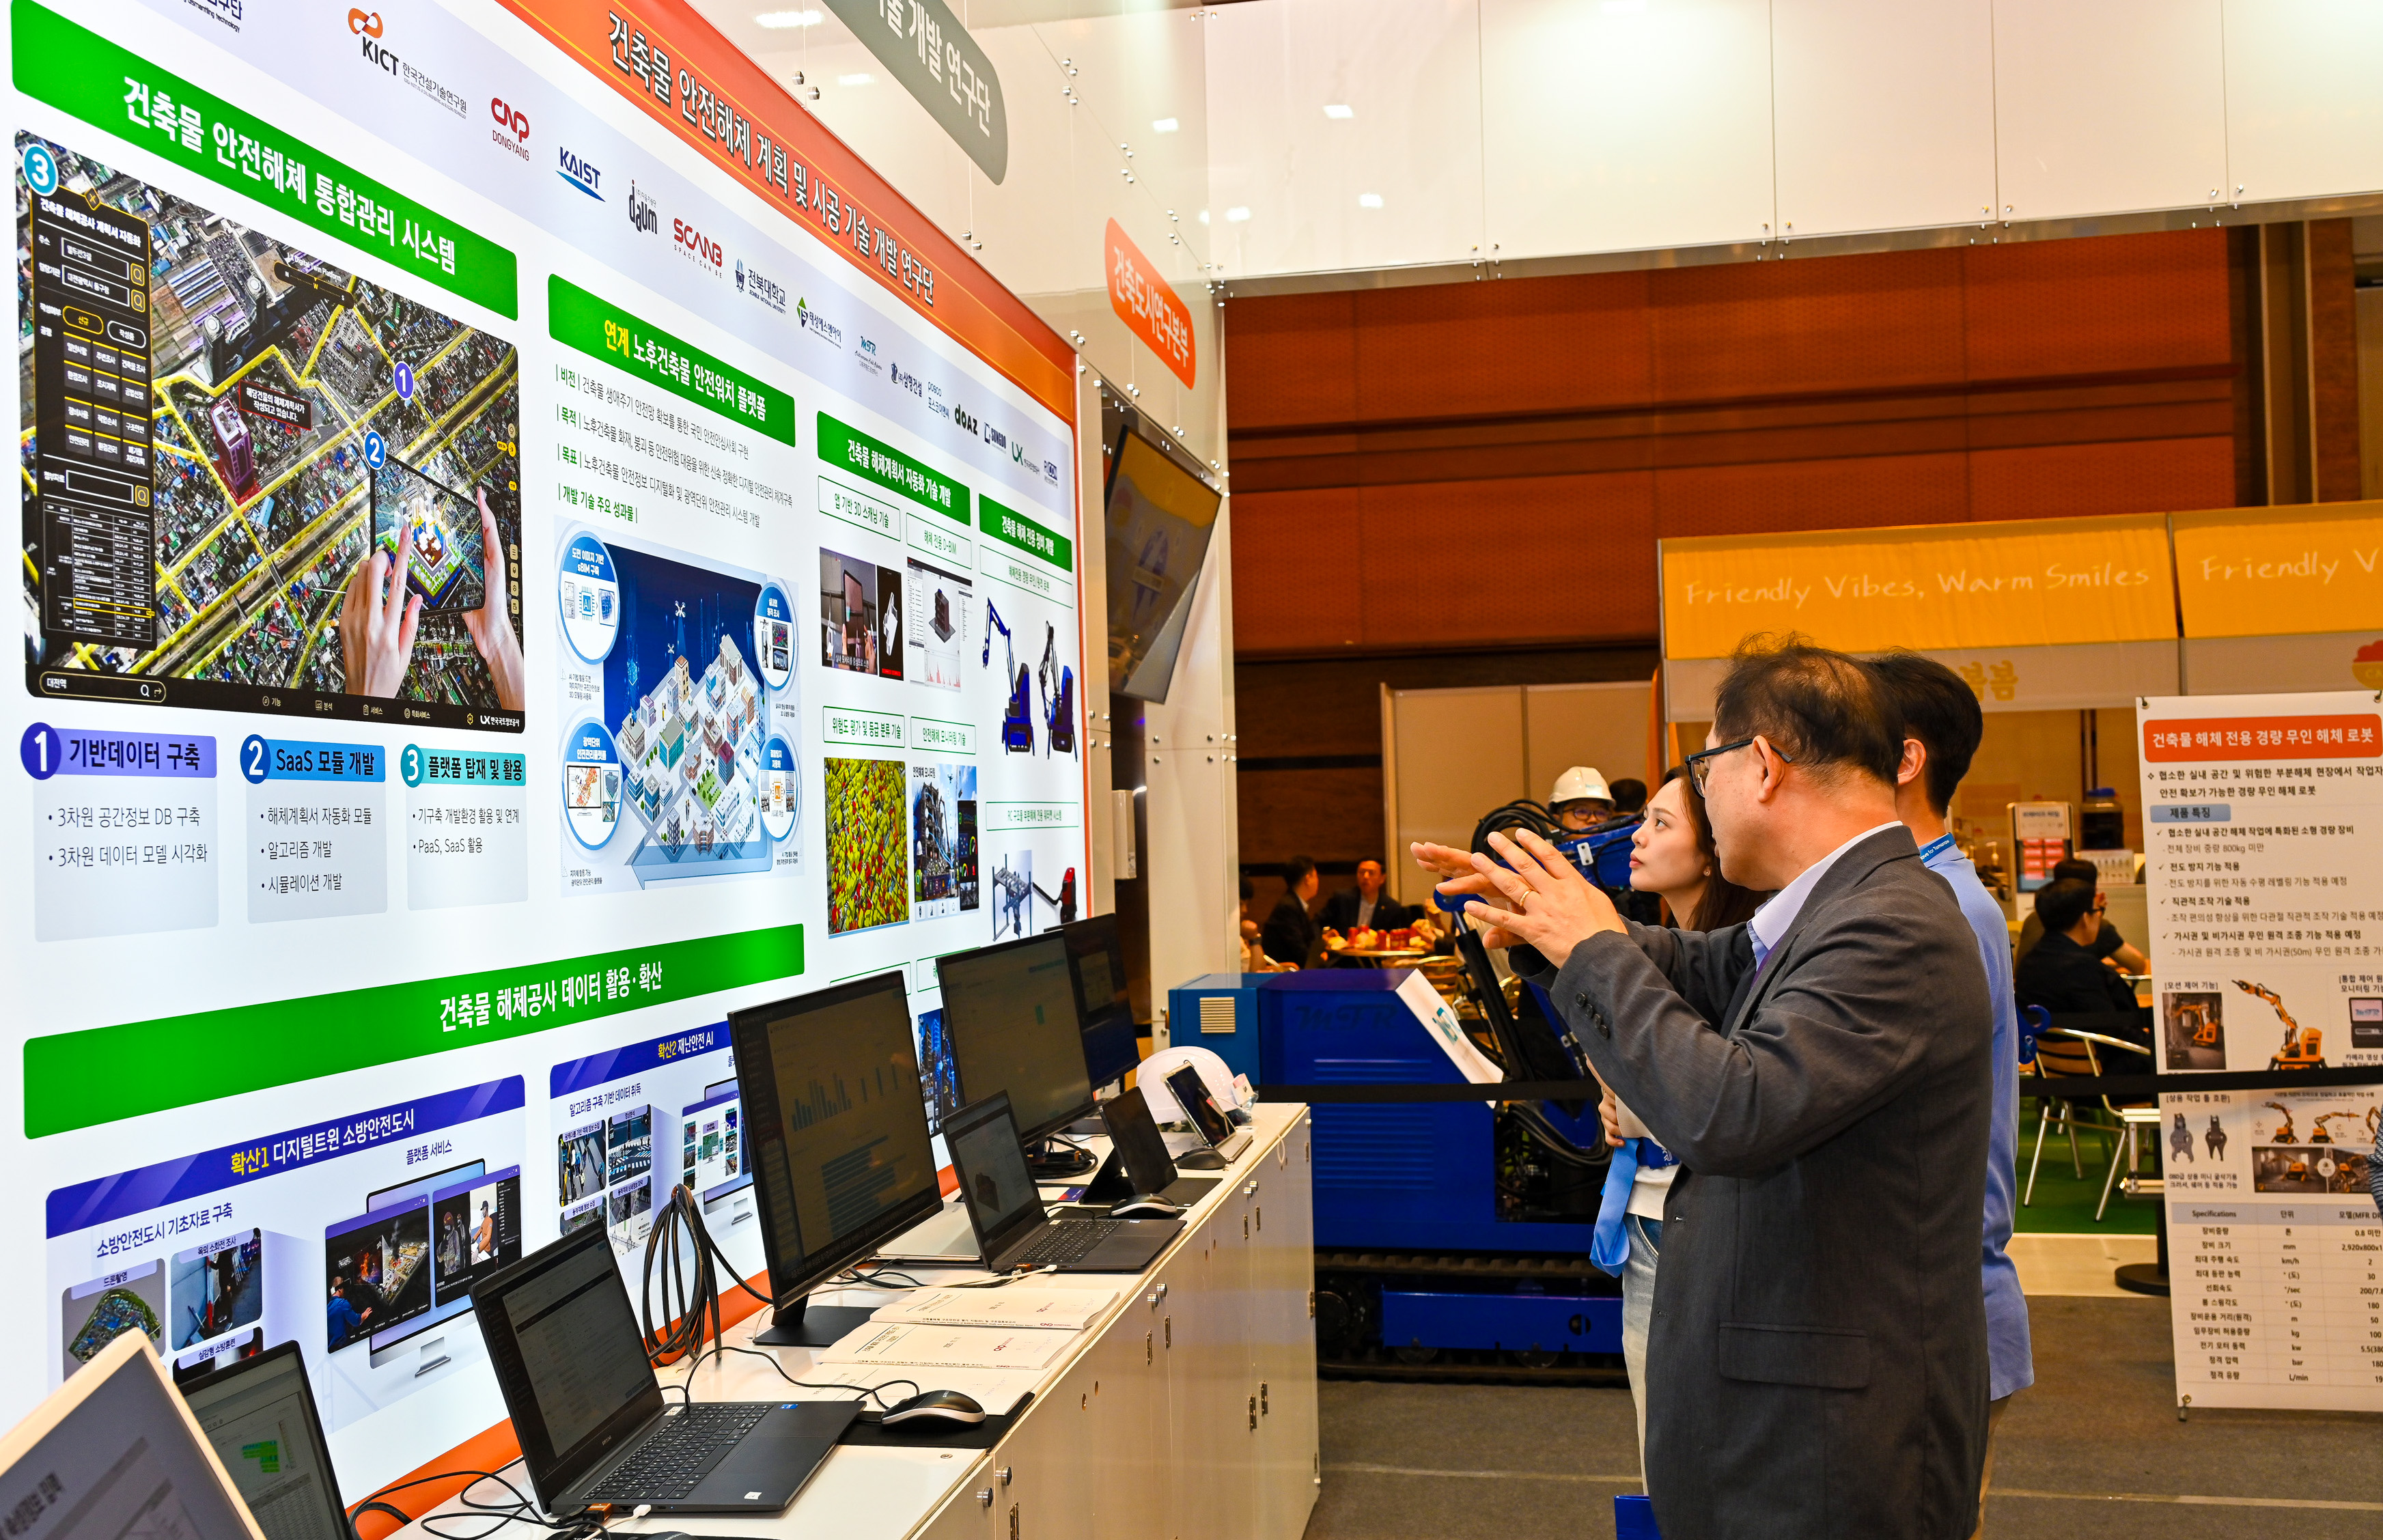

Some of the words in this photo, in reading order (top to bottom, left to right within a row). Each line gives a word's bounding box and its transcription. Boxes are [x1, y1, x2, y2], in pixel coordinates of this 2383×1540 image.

[363, 36, 398, 76] KICT
[879, 0, 904, 39] 술
[908, 0, 942, 83] 개발
[947, 42, 990, 138] 연구단
[403, 62, 466, 113] 한국건설기술연구원
[492, 130, 529, 161] DONGYANG
[608, 10, 672, 109] 건축물
[678, 68, 751, 169] 안전해체
[757, 122, 788, 199] 계획
[794, 161, 808, 210] 및
[812, 177, 839, 236] 시공
[846, 199, 870, 255] 기술
[874, 223, 897, 275] 개발
[901, 247, 934, 307] 연구단
[31, 154, 48, 186] 3
[124, 76, 202, 154] 건축물
[212, 121, 307, 204] 안전해체
[315, 175, 393, 241] 통합관리
[402, 221, 456, 275] 시스템
[559, 146, 600, 190] KAIST
[674, 244, 695, 262] SPACE
[699, 260, 711, 272] CAN
[749, 268, 785, 307] 전북대학교
[1114, 246, 1188, 367] 건축도시연구본부
[399, 369, 406, 391] 1
[604, 320, 628, 358] 연계
[634, 334, 691, 387] 노후건축물
[694, 363, 734, 408] 안전워치
[738, 386, 766, 422] 플랫폼
[928, 381, 941, 397] posco
[561, 367, 575, 388] 비전
[583, 377, 603, 400] 건축물
[607, 387, 633, 415] 생애주기
[635, 399, 654, 421] 안전망
[657, 408, 675, 429] 확보를
[677, 417, 689, 435] 통한
[691, 424, 702, 441] 국민
[738, 443, 748, 460] 구현
[369, 438, 380, 462] 2
[848, 439, 869, 468] 건축물
[872, 450, 904, 486] 해체계획서
[906, 468, 924, 495] 자동화
[926, 478, 938, 501] 기술
[939, 485, 951, 508] 개발
[563, 486, 578, 504] 개발
[581, 490, 595, 510] 기술
[598, 497, 611, 514] 주요
[613, 501, 633, 522] 성과물
[835, 493, 839, 509] 앱
[841, 494, 852, 515] 기반
[854, 502, 861, 517] 3D
[863, 504, 878, 524] 스캐닝
[880, 510, 889, 529] 기술
[1684, 578, 1812, 608] Friendly
[1825, 574, 1924, 600] Vibes,
[1938, 568, 2033, 592] Warm
[2046, 561, 2149, 589] Smiles
[2200, 550, 2339, 585] Friendly
[272, 697, 281, 706] 기능
[324, 703, 333, 711] 분석
[371, 707, 382, 715] 서비스
[34, 731, 47, 772] 1
[70, 739, 159, 769] 기반데이터
[167, 743, 199, 770] 구축
[2153, 733, 2192, 748] 건축물
[2196, 731, 2221, 747] 해체
[2226, 731, 2252, 746] 전용
[2257, 729, 2283, 745] 경량
[2287, 729, 2312, 745] 무인
[2317, 728, 2342, 743] 해체
[2347, 727, 2373, 743] 로봇
[249, 740, 264, 775] 2
[277, 749, 312, 772] SaaS
[318, 751, 344, 775] 모듈
[350, 753, 374, 776] 개발
[408, 749, 419, 781] 3
[429, 756, 460, 779] 플랫폼
[466, 758, 486, 779] 탑재
[490, 759, 499, 780] 및
[503, 759, 522, 781] 활용
[2160, 770, 2185, 781] 협소한
[2190, 770, 2206, 779] 실내
[2211, 770, 2228, 779] 공간
[2233, 769, 2241, 779] 및
[2246, 768, 2271, 778] 위험한
[2276, 767, 2312, 777] 부분해체
[2317, 766, 2352, 776] 현장에서
[2356, 766, 2382, 776] 작업자
[58, 807, 93, 828] 3차원
[99, 807, 150, 828] 공간정보
[156, 808, 172, 825] DB
[177, 807, 200, 826] 구축
[268, 807, 318, 825] 해체계획서
[322, 808, 350, 825] 자동화
[354, 808, 372, 824] 모듈
[419, 809, 442, 824] 기구축
[445, 809, 475, 824] 개발환경
[479, 809, 493, 824] 활용
[496, 809, 503, 824] 및
[505, 808, 519, 824] 연계
[2170, 808, 2188, 818] 제품
[2192, 807, 2210, 818] 특징
[58, 846, 94, 867] 3차원
[100, 845, 137, 866] 데이터
[143, 845, 167, 864] 모델
[172, 844, 207, 863] 시각화
[268, 841, 309, 860] 알고리즘
[312, 841, 332, 858] 개발
[419, 839, 442, 855] PaaS,
[445, 839, 464, 852] SaaS
[468, 838, 482, 854] 활용
[268, 875, 319, 894] 시뮬레이션
[323, 873, 342, 891] 개발
[439, 992, 490, 1033] 건축물
[497, 972, 557, 1021] 해체공사
[561, 971, 601, 1007] 데이터
[658, 1041, 676, 1060] 확산2
[678, 1035, 705, 1054] 재난안전
[706, 1031, 714, 1046] AI
[569, 1096, 592, 1117] 알고리즘
[594, 1094, 604, 1108] 구축
[604, 1091, 614, 1107] 기반
[615, 1087, 630, 1104] 데이터
[632, 1082, 641, 1097] 취득
[231, 1146, 268, 1176] 확산1
[274, 1127, 340, 1164] 디지털트윈
[343, 1108, 415, 1146] 소방안전도시
[406, 1143, 429, 1165] 플랫폼
[430, 1139, 452, 1158] 서비스
[97, 1221, 165, 1258] 소방안전도시
[168, 1209, 210, 1235] 기초자료
[212, 1202, 232, 1223] 구축
